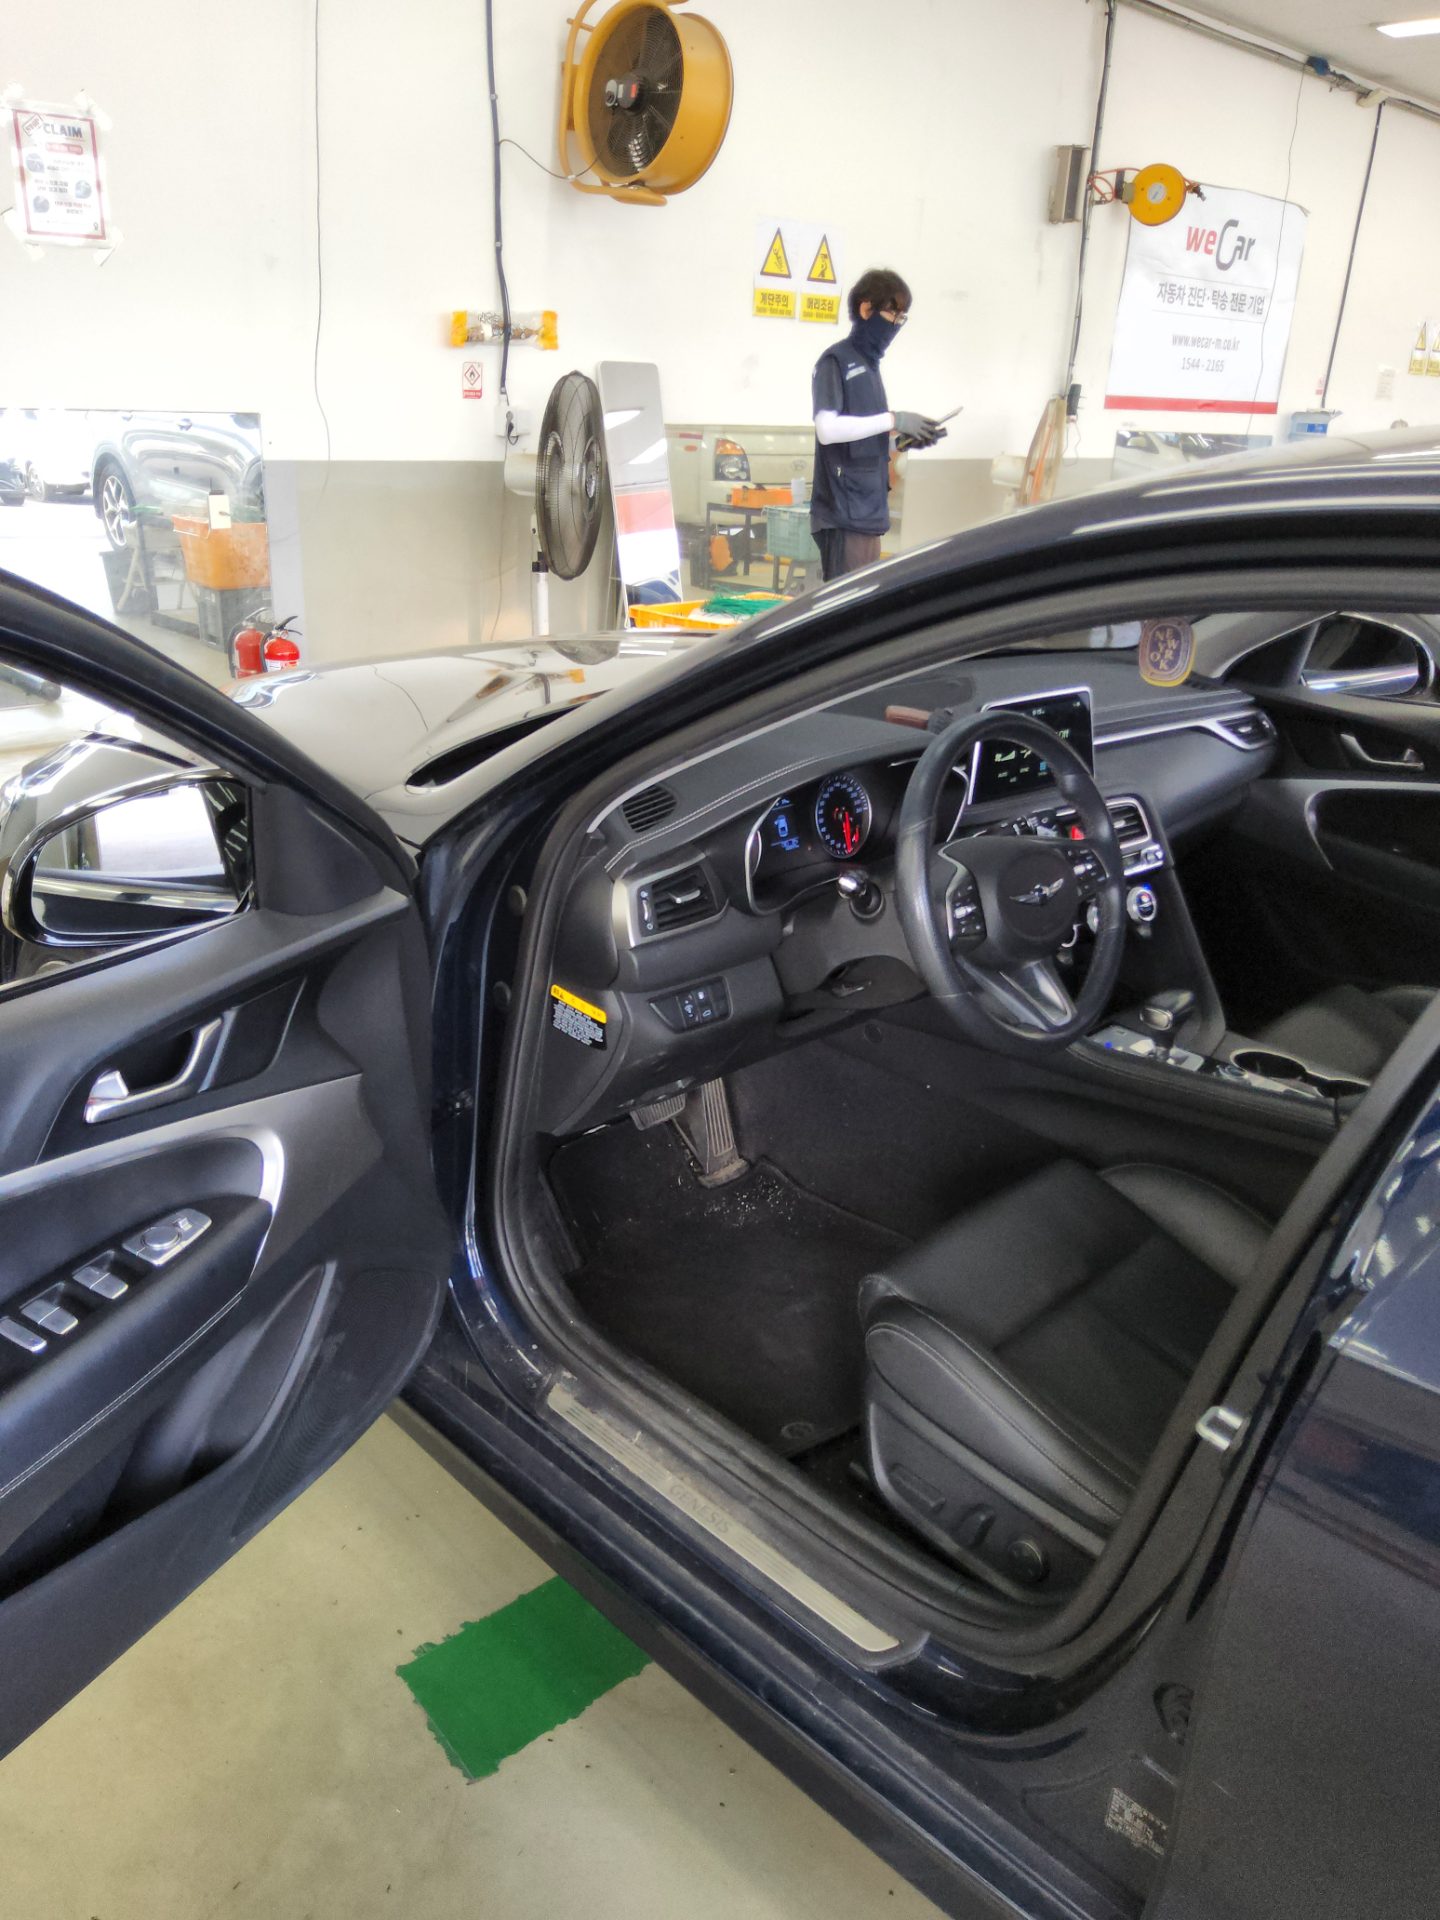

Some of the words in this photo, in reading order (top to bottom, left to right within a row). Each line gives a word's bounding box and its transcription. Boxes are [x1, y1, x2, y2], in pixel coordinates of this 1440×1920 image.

[43, 122, 83, 138] CLAIM
[1185, 218, 1257, 272] weCar
[760, 292, 789, 308] 계단주의
[806, 297, 834, 312] 머리조심
[1157, 282, 1187, 306] 자동차
[1230, 292, 1247, 313] 전문
[1247, 295, 1265, 316] 기업
[1172, 334, 1240, 351] www.wecar-m.co.kr
[669, 1484, 733, 1534] GENESIS
